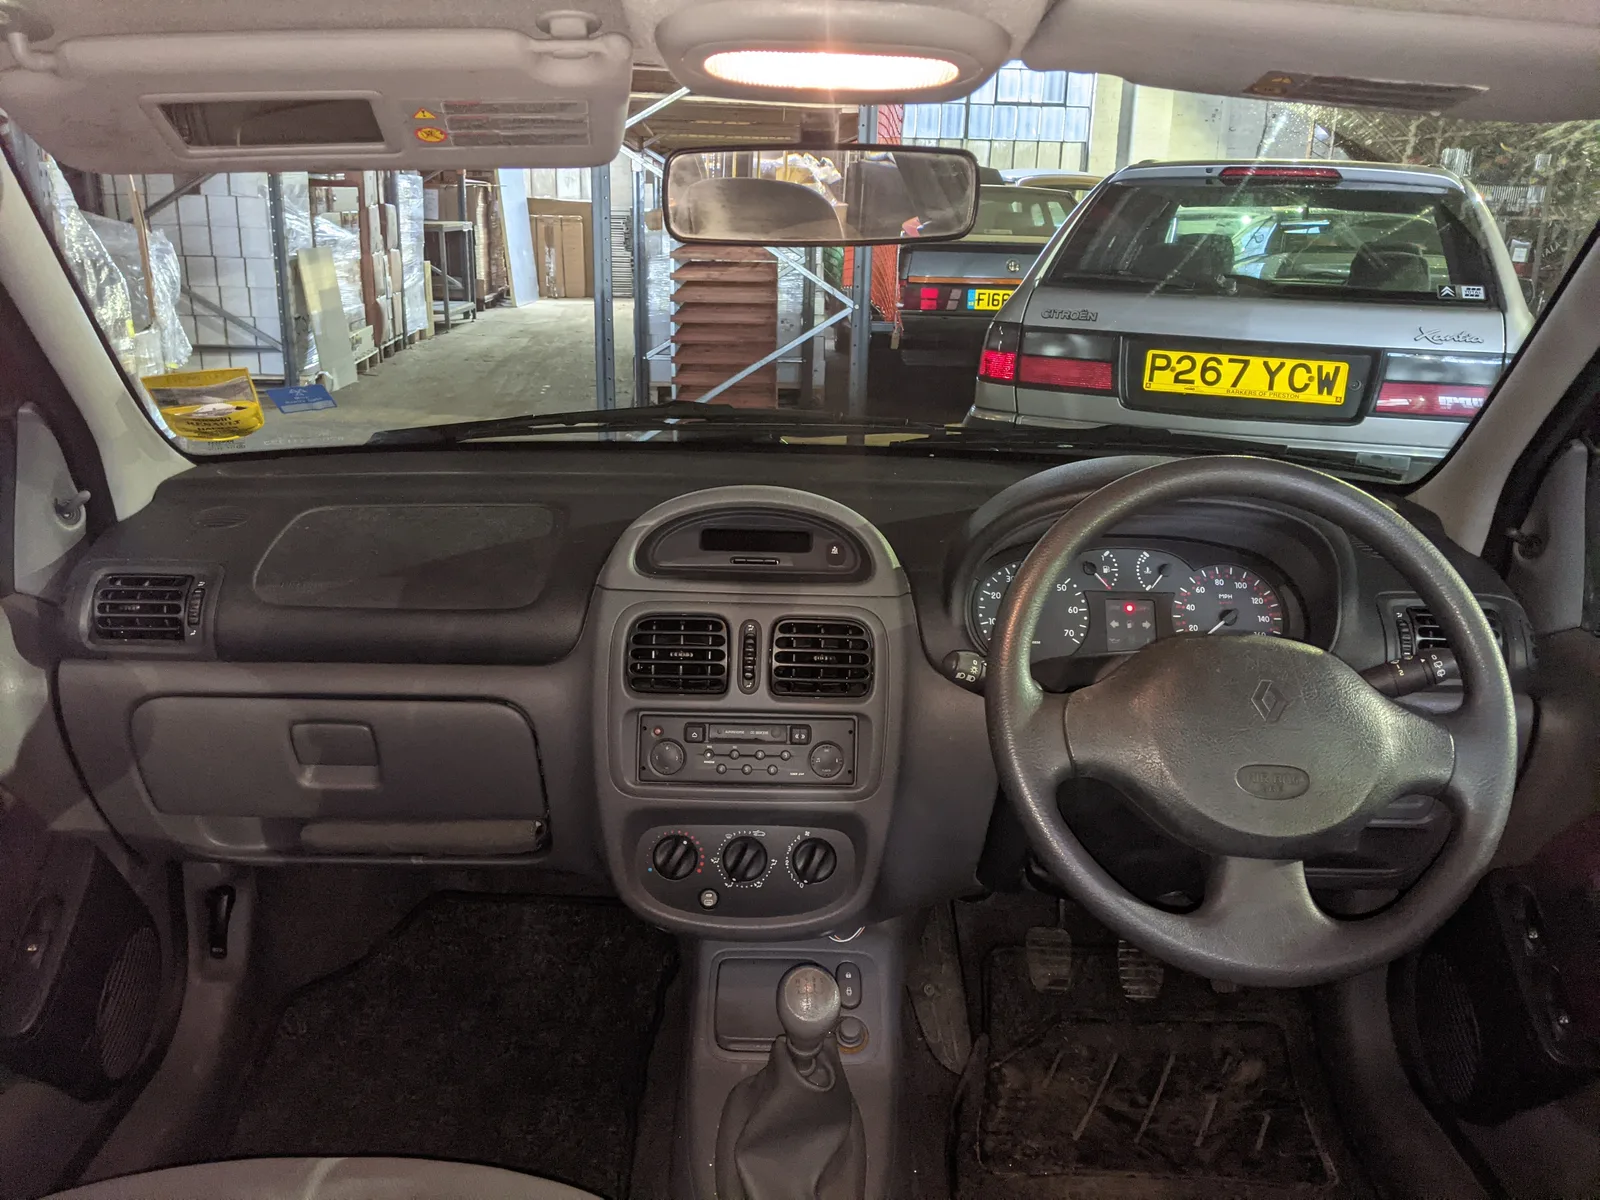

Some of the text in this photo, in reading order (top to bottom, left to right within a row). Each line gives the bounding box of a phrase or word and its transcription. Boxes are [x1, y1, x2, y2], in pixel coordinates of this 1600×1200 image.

[1041, 309, 1098, 322] CITROËN
[1413, 326, 1484, 345] Xantia
[1148, 353, 1341, 396] P267 YCW
[1226, 388, 1257, 397] BARKERS
[1269, 391, 1300, 399] PRESTON
[1251, 597, 1263, 605] 120
